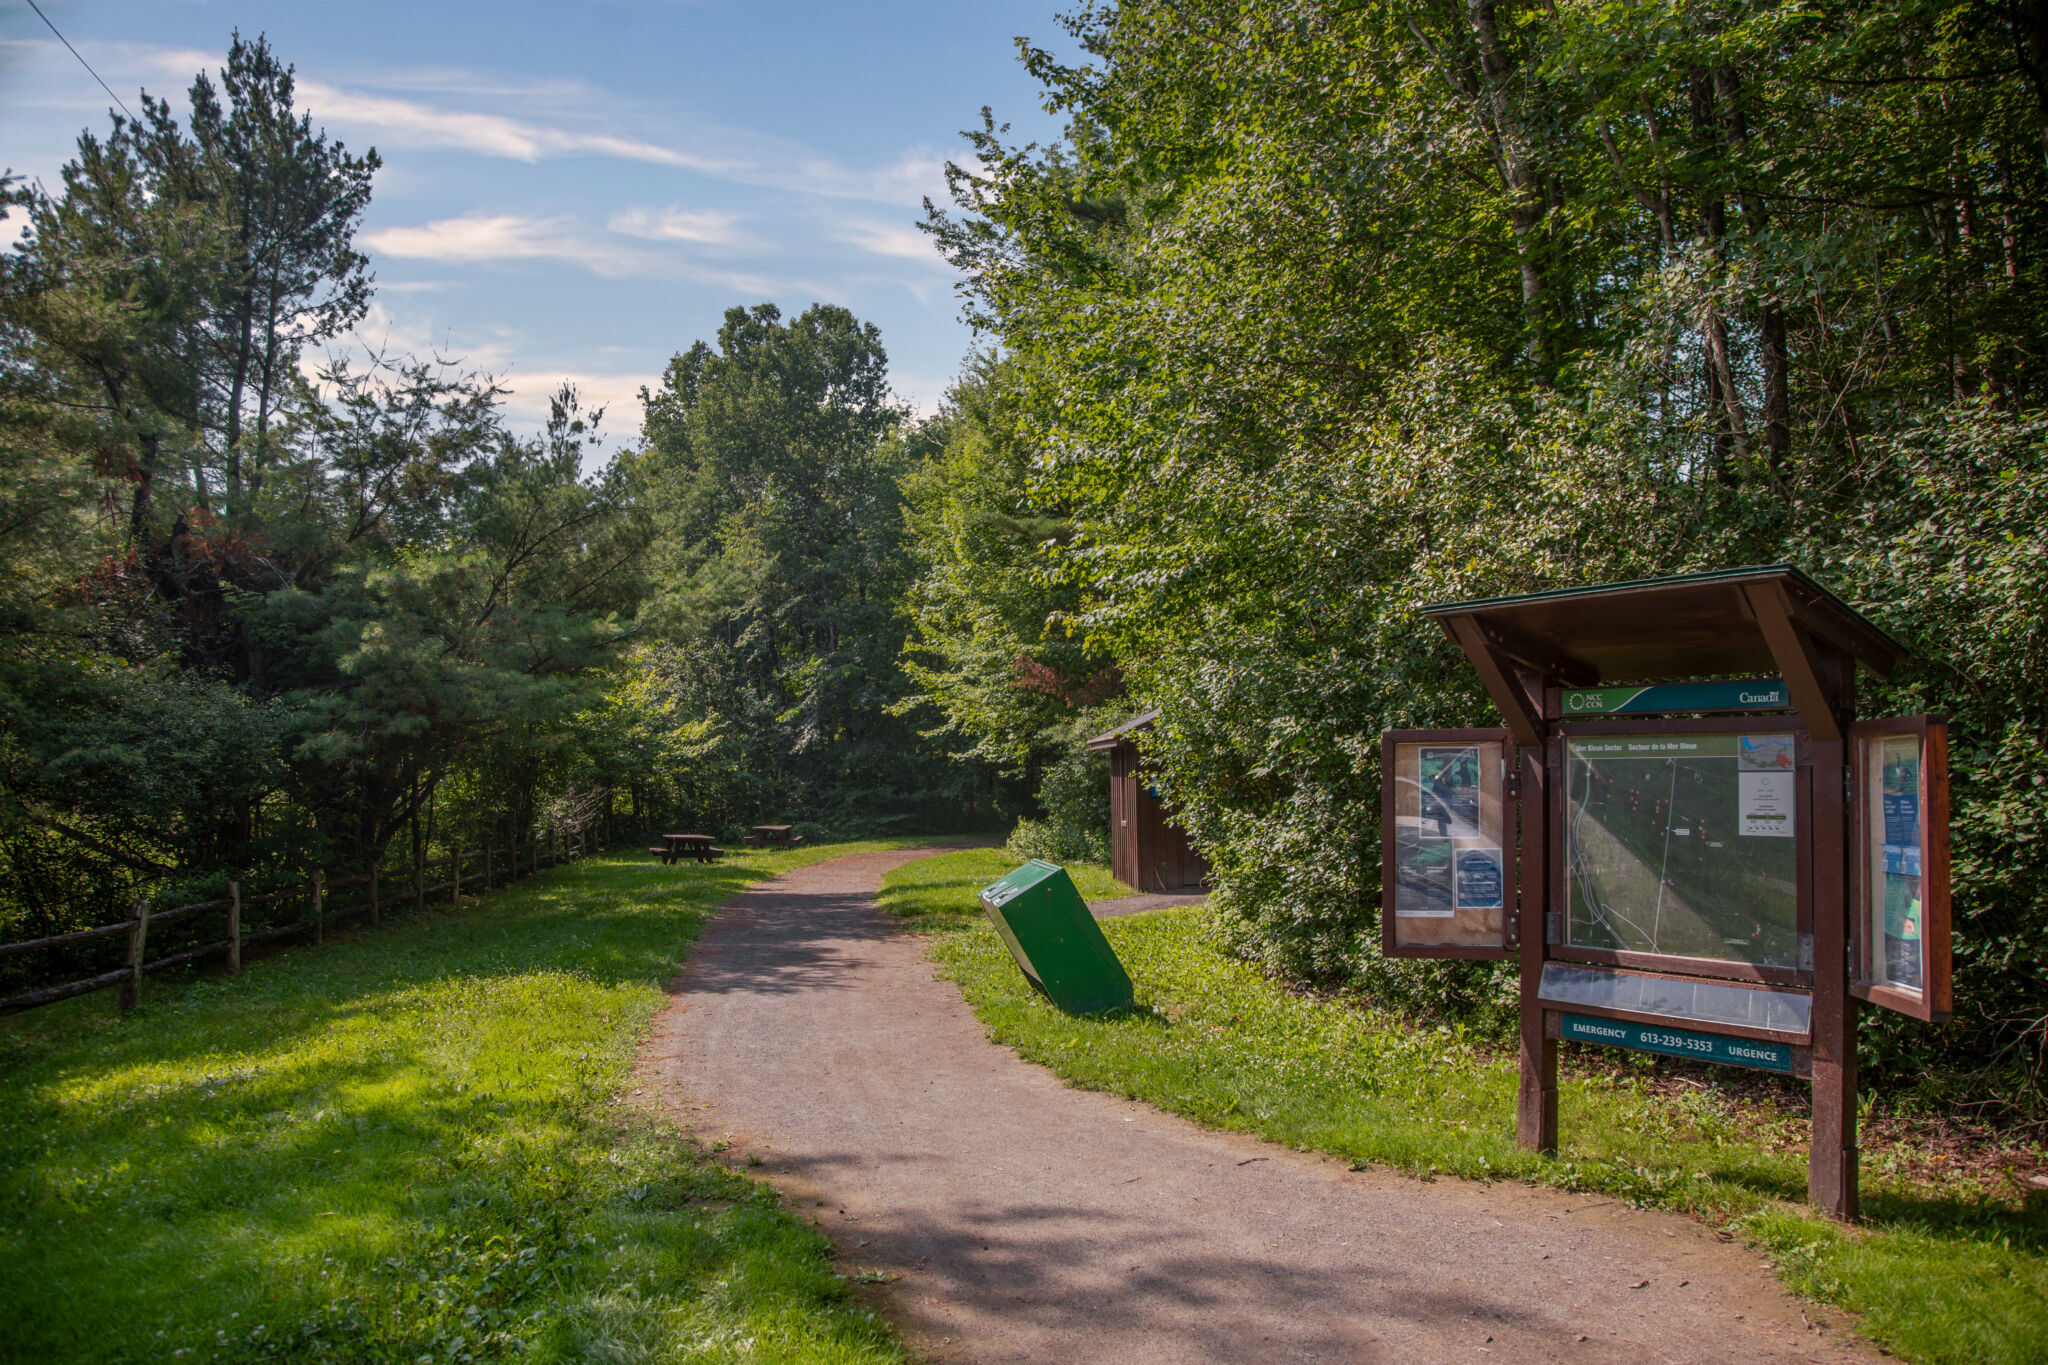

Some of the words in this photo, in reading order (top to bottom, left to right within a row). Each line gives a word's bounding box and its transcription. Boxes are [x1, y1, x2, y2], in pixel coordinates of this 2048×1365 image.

[1586, 693, 1603, 701] NCC
[1739, 691, 1780, 704] Canada
[1575, 744, 1586, 752] Mer
[1587, 744, 1604, 752] Bleue
[1604, 744, 1622, 752] Sector
[1628, 743, 1650, 751] Secteur
[1667, 742, 1679, 750] Mer
[1680, 742, 1697, 750] Bleue
[1573, 1023, 1627, 1039] EMERGENCY
[1640, 1032, 1713, 1052] 613-239-5353
[1728, 1046, 1777, 1062] URGENCE
